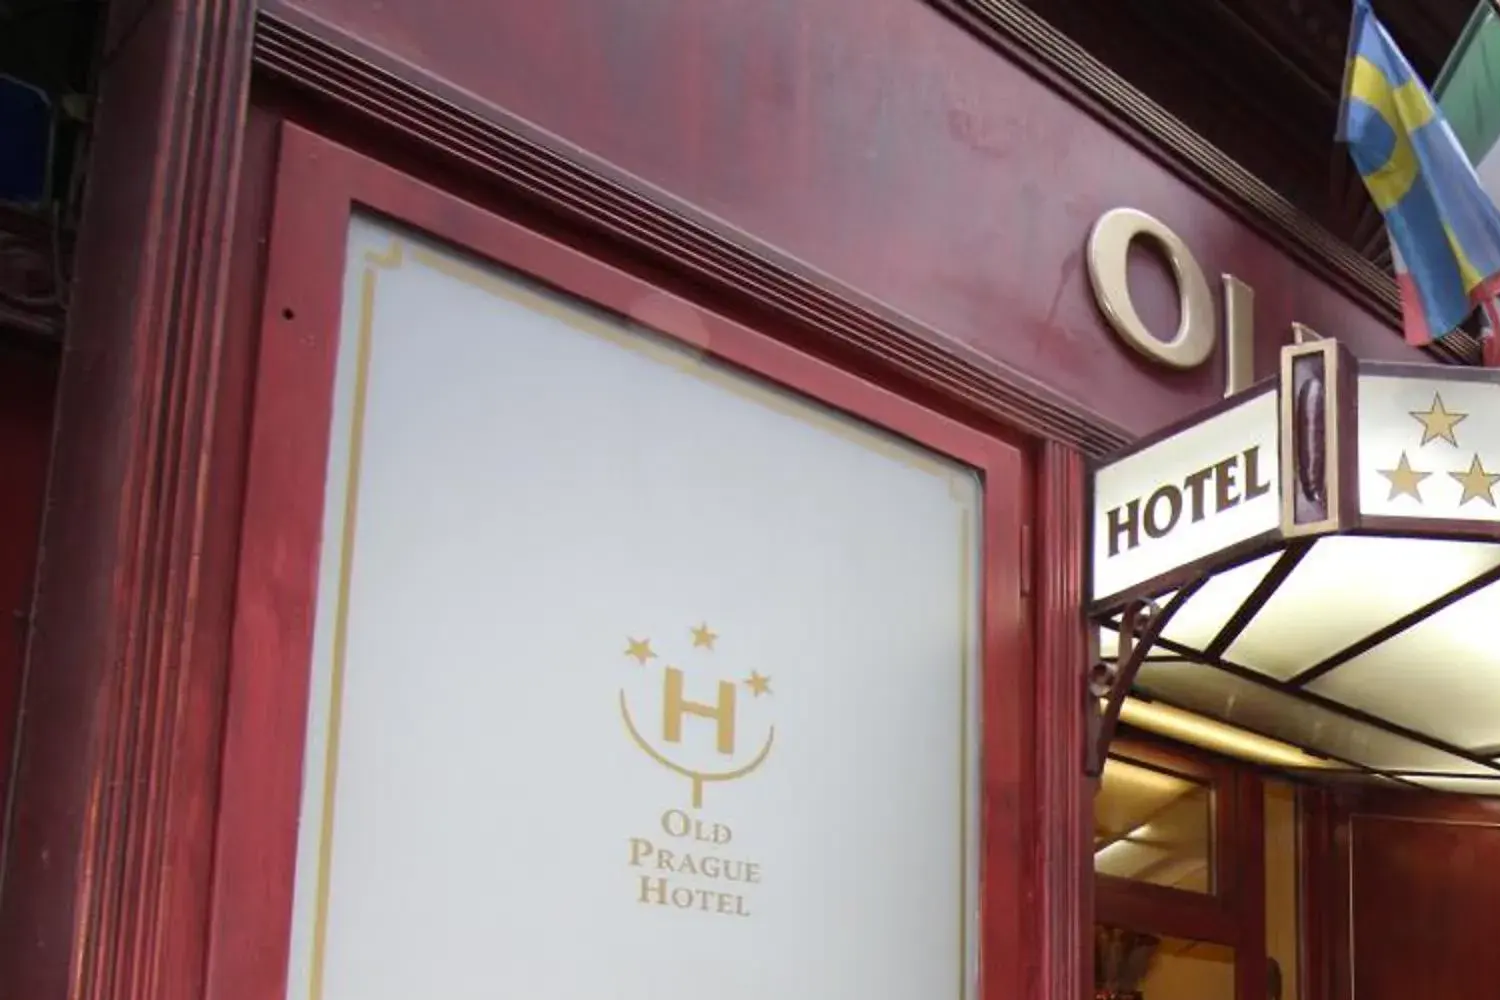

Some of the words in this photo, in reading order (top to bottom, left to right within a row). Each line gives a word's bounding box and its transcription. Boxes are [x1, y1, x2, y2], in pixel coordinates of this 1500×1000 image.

[1087, 207, 1325, 399] OL
[1106, 445, 1271, 558] HOTEL
[660, 808, 732, 845] OLD
[627, 836, 762, 884] PRAGUE
[637, 875, 751, 918] HOTEL
